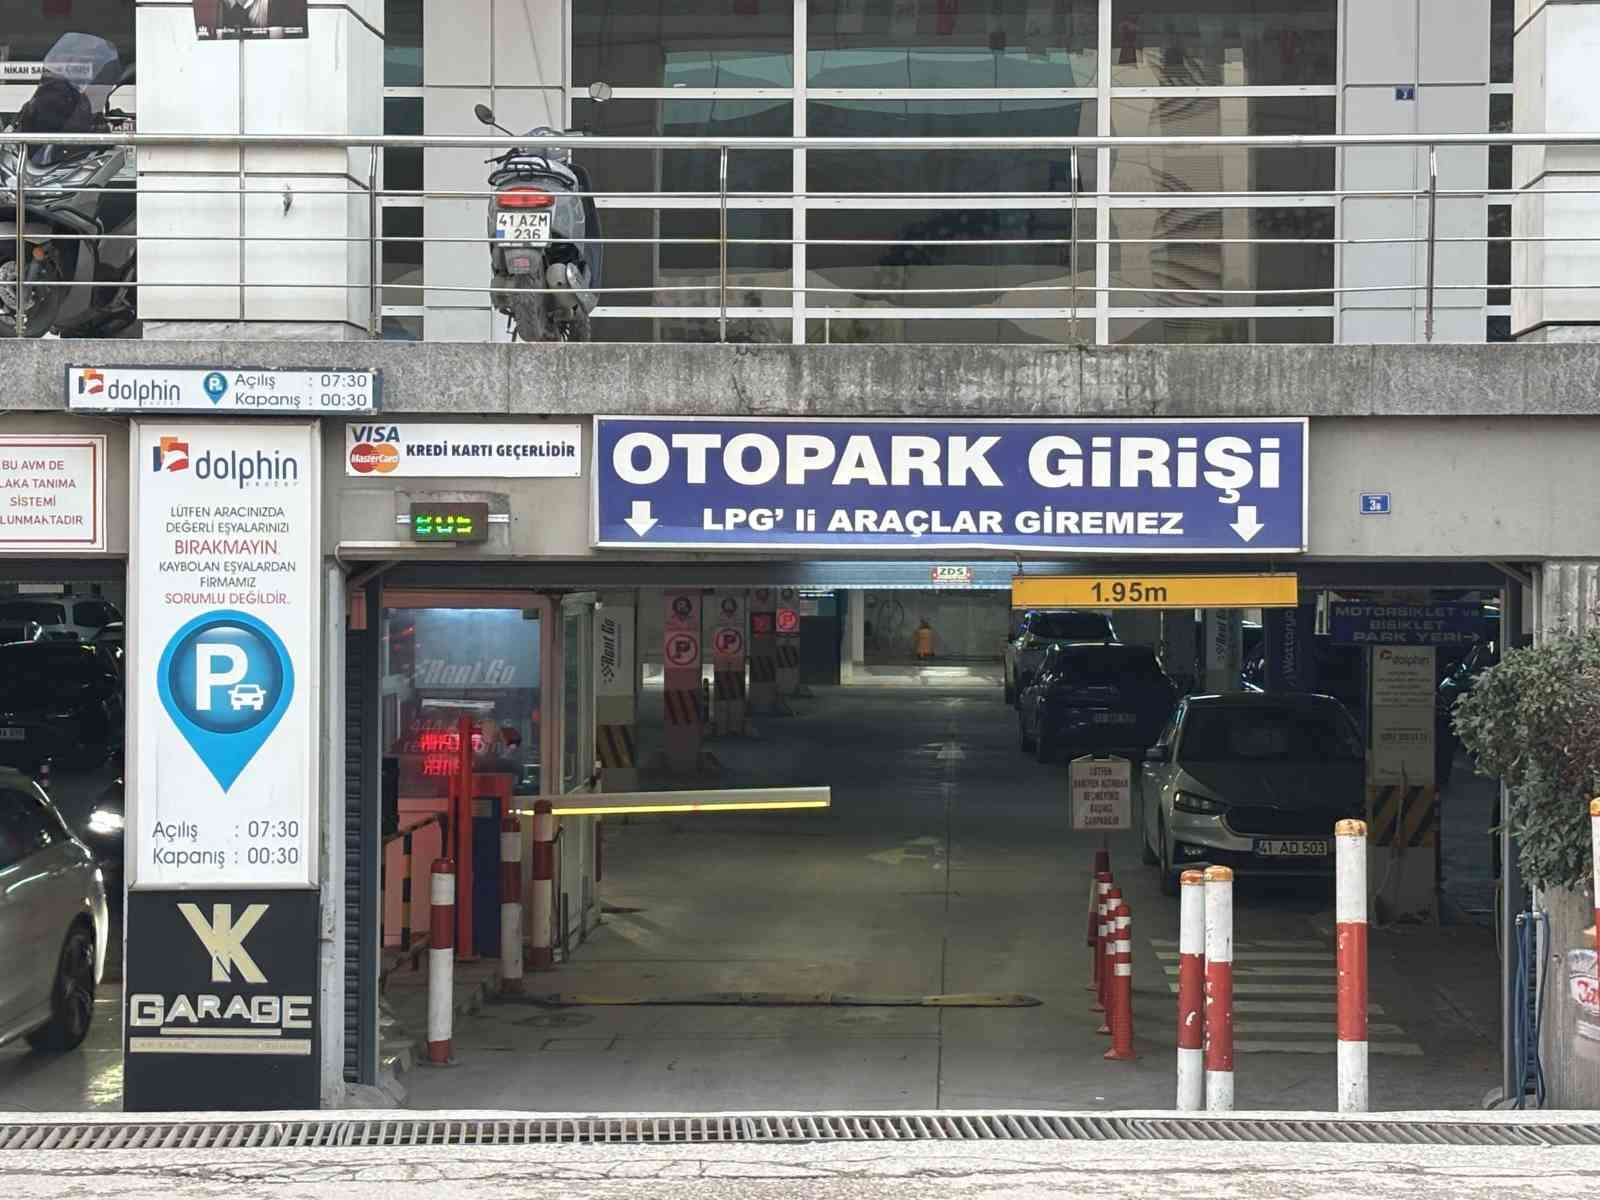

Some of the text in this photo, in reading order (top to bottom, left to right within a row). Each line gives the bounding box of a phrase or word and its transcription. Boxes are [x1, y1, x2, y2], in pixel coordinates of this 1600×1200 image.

[499, 215, 547, 226] 41 AZM
[514, 229, 541, 239] 236
[235, 374, 276, 389] Açılış
[321, 374, 368, 388] 07:30
[108, 379, 180, 405] dolphin
[235, 392, 301, 407] Kapanış
[320, 393, 367, 407] 00:30
[352, 426, 400, 442] VISA
[406, 441, 575, 460] KREDİ KARTI GEÇERLİDİR
[2, 459, 65, 471] BU AVM DE
[612, 431, 1004, 488] OTOPARK
[195, 451, 297, 488] dolphin
[32, 478, 77, 489] TANIMA
[9, 494, 57, 507] SİSTEMİ
[170, 504, 285, 518] LÜTFEN ARACINIZDA
[166, 519, 289, 535] DEĞERLİ EŞYALARINIZI
[827, 509, 1003, 537] ARAÇLAR
[1014, 506, 1184, 535] GİREMEZ
[159, 561, 296, 574] KAYBOLAN EŞYALARDAN
[939, 567, 964, 576] ZDS
[200, 577, 256, 588] FİRMAMIZ
[165, 593, 225, 605] SORUMLU
[1091, 582, 1167, 603] 1.95m
[1353, 632, 1407, 642] PARK
[196, 643, 248, 711] P
[152, 821, 199, 842] Açılış
[247, 820, 299, 838] 07:30
[1280, 842, 1297, 853] AD
[1302, 842, 1325, 853] 503
[152, 848, 225, 868] Kapanış
[247, 848, 298, 864] 00:30
[129, 994, 312, 1028] GARAGE
